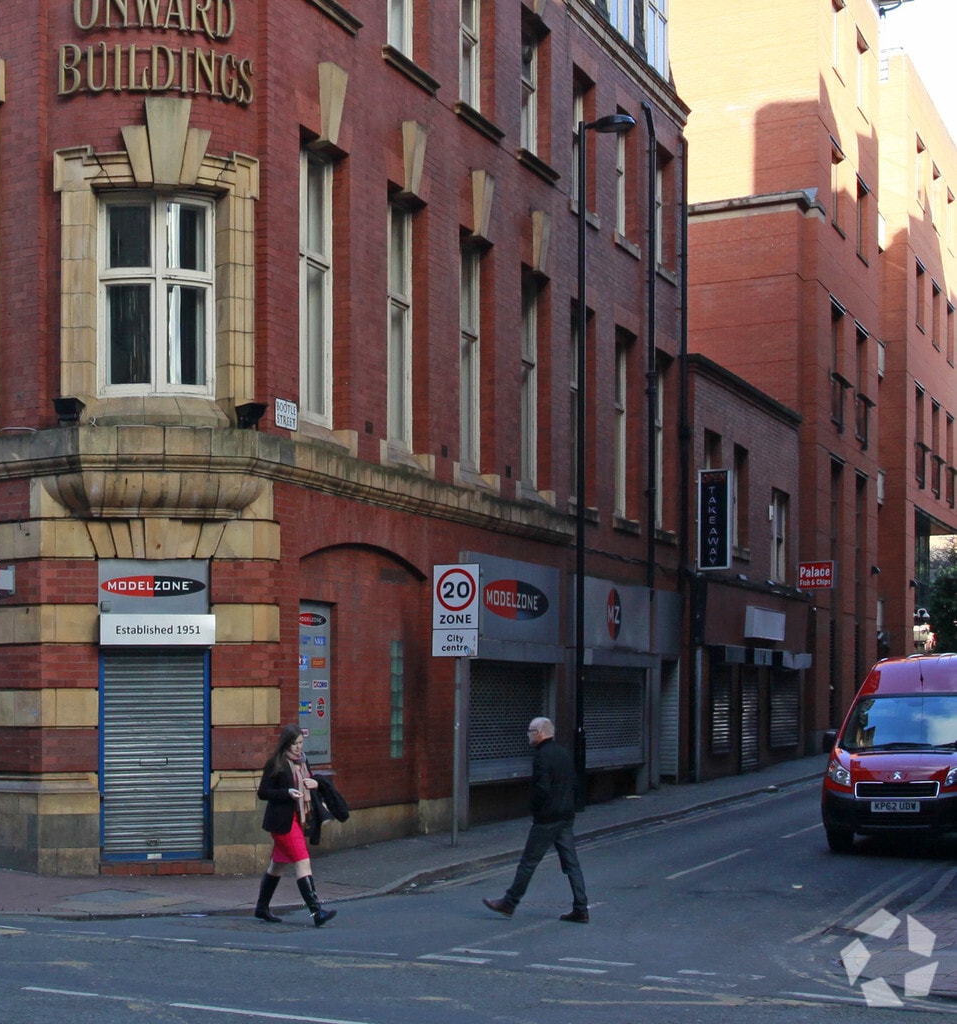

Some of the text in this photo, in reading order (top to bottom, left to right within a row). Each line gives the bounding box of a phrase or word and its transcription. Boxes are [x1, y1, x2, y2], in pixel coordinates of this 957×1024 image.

[58, 41, 254, 105] BUILDINGS
[276, 401, 296, 416] BOOTLE
[276, 414, 296, 428] STREET
[707, 486, 719, 565] TAKEAWAY
[800, 566, 831, 578] Palace
[107, 581, 190, 591] MODELZONE
[816, 578, 831, 586] Chips
[442, 581, 470, 599] 20
[486, 589, 539, 611] MODELZONE
[439, 614, 472, 625] ZONE
[607, 605, 620, 624] MZ
[115, 625, 201, 635] Established 1951
[446, 634, 464, 643] City
[441, 643, 468, 652] centre
